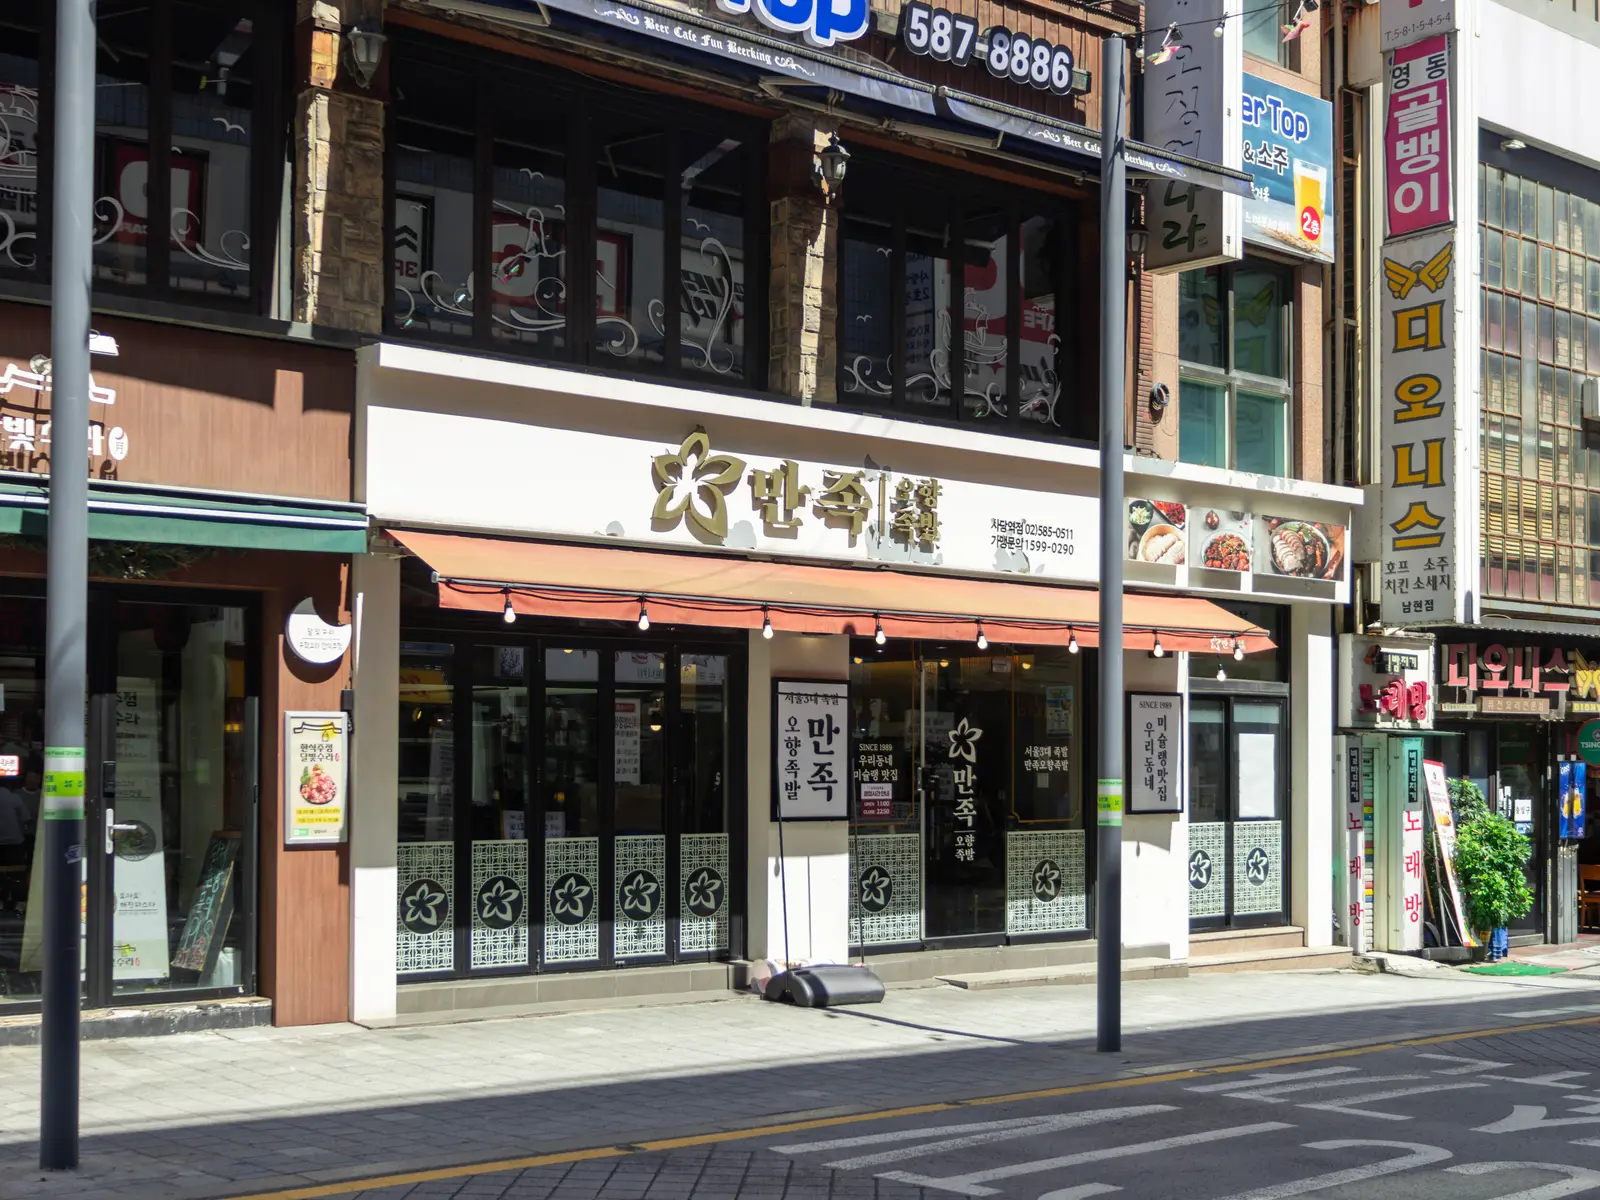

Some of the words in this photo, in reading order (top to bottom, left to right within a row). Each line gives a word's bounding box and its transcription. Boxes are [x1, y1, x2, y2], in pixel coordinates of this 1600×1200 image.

[643, 16, 670, 35] Beer
[673, 25, 697, 43] Cafe
[700, 34, 723, 50] Fun
[727, 39, 772, 66] Beerking
[905, 3, 1073, 93] 587-8886
[1267, 95, 1309, 143] Top
[1243, 140, 1256, 164] &
[1256, 140, 1290, 176] 소주
[1393, 85, 1443, 213] 골뱅이
[1302, 211, 1320, 235] 2층
[1389, 298, 1447, 552] 디오니스
[748, 459, 873, 538] 만족
[991, 518, 1024, 536] 사당역점
[1025, 523, 1073, 540] 02)585-0511
[991, 534, 1024, 551] 가맹문의
[1025, 540, 1074, 556] 1599-0290
[1384, 560, 1410, 575] 호프
[1423, 556, 1449, 573] 소주
[1384, 577, 1410, 595] 치킨
[1412, 573, 1451, 592] 소세지
[1402, 599, 1434, 614] 남현점
[1447, 643, 1570, 693] 디오니스
[1139, 701, 1159, 710] SINCE
[1159, 702, 1173, 710] 1989
[783, 715, 801, 801] 오향족발
[806, 713, 841, 802] 만족
[858, 744, 878, 752] SINCE
[879, 744, 893, 752] 1989
[858, 754, 893, 767] 우리동네
[1024, 746, 1052, 758] 서울3대
[1144, 721, 1155, 791] 우리동네
[881, 769, 899, 782] 맛집
[953, 765, 977, 828] 만족
[954, 833, 975, 847] 오향
[954, 848, 975, 862] 족발
[1348, 811, 1364, 927] 노래방
[1404, 810, 1422, 923] 노래방
